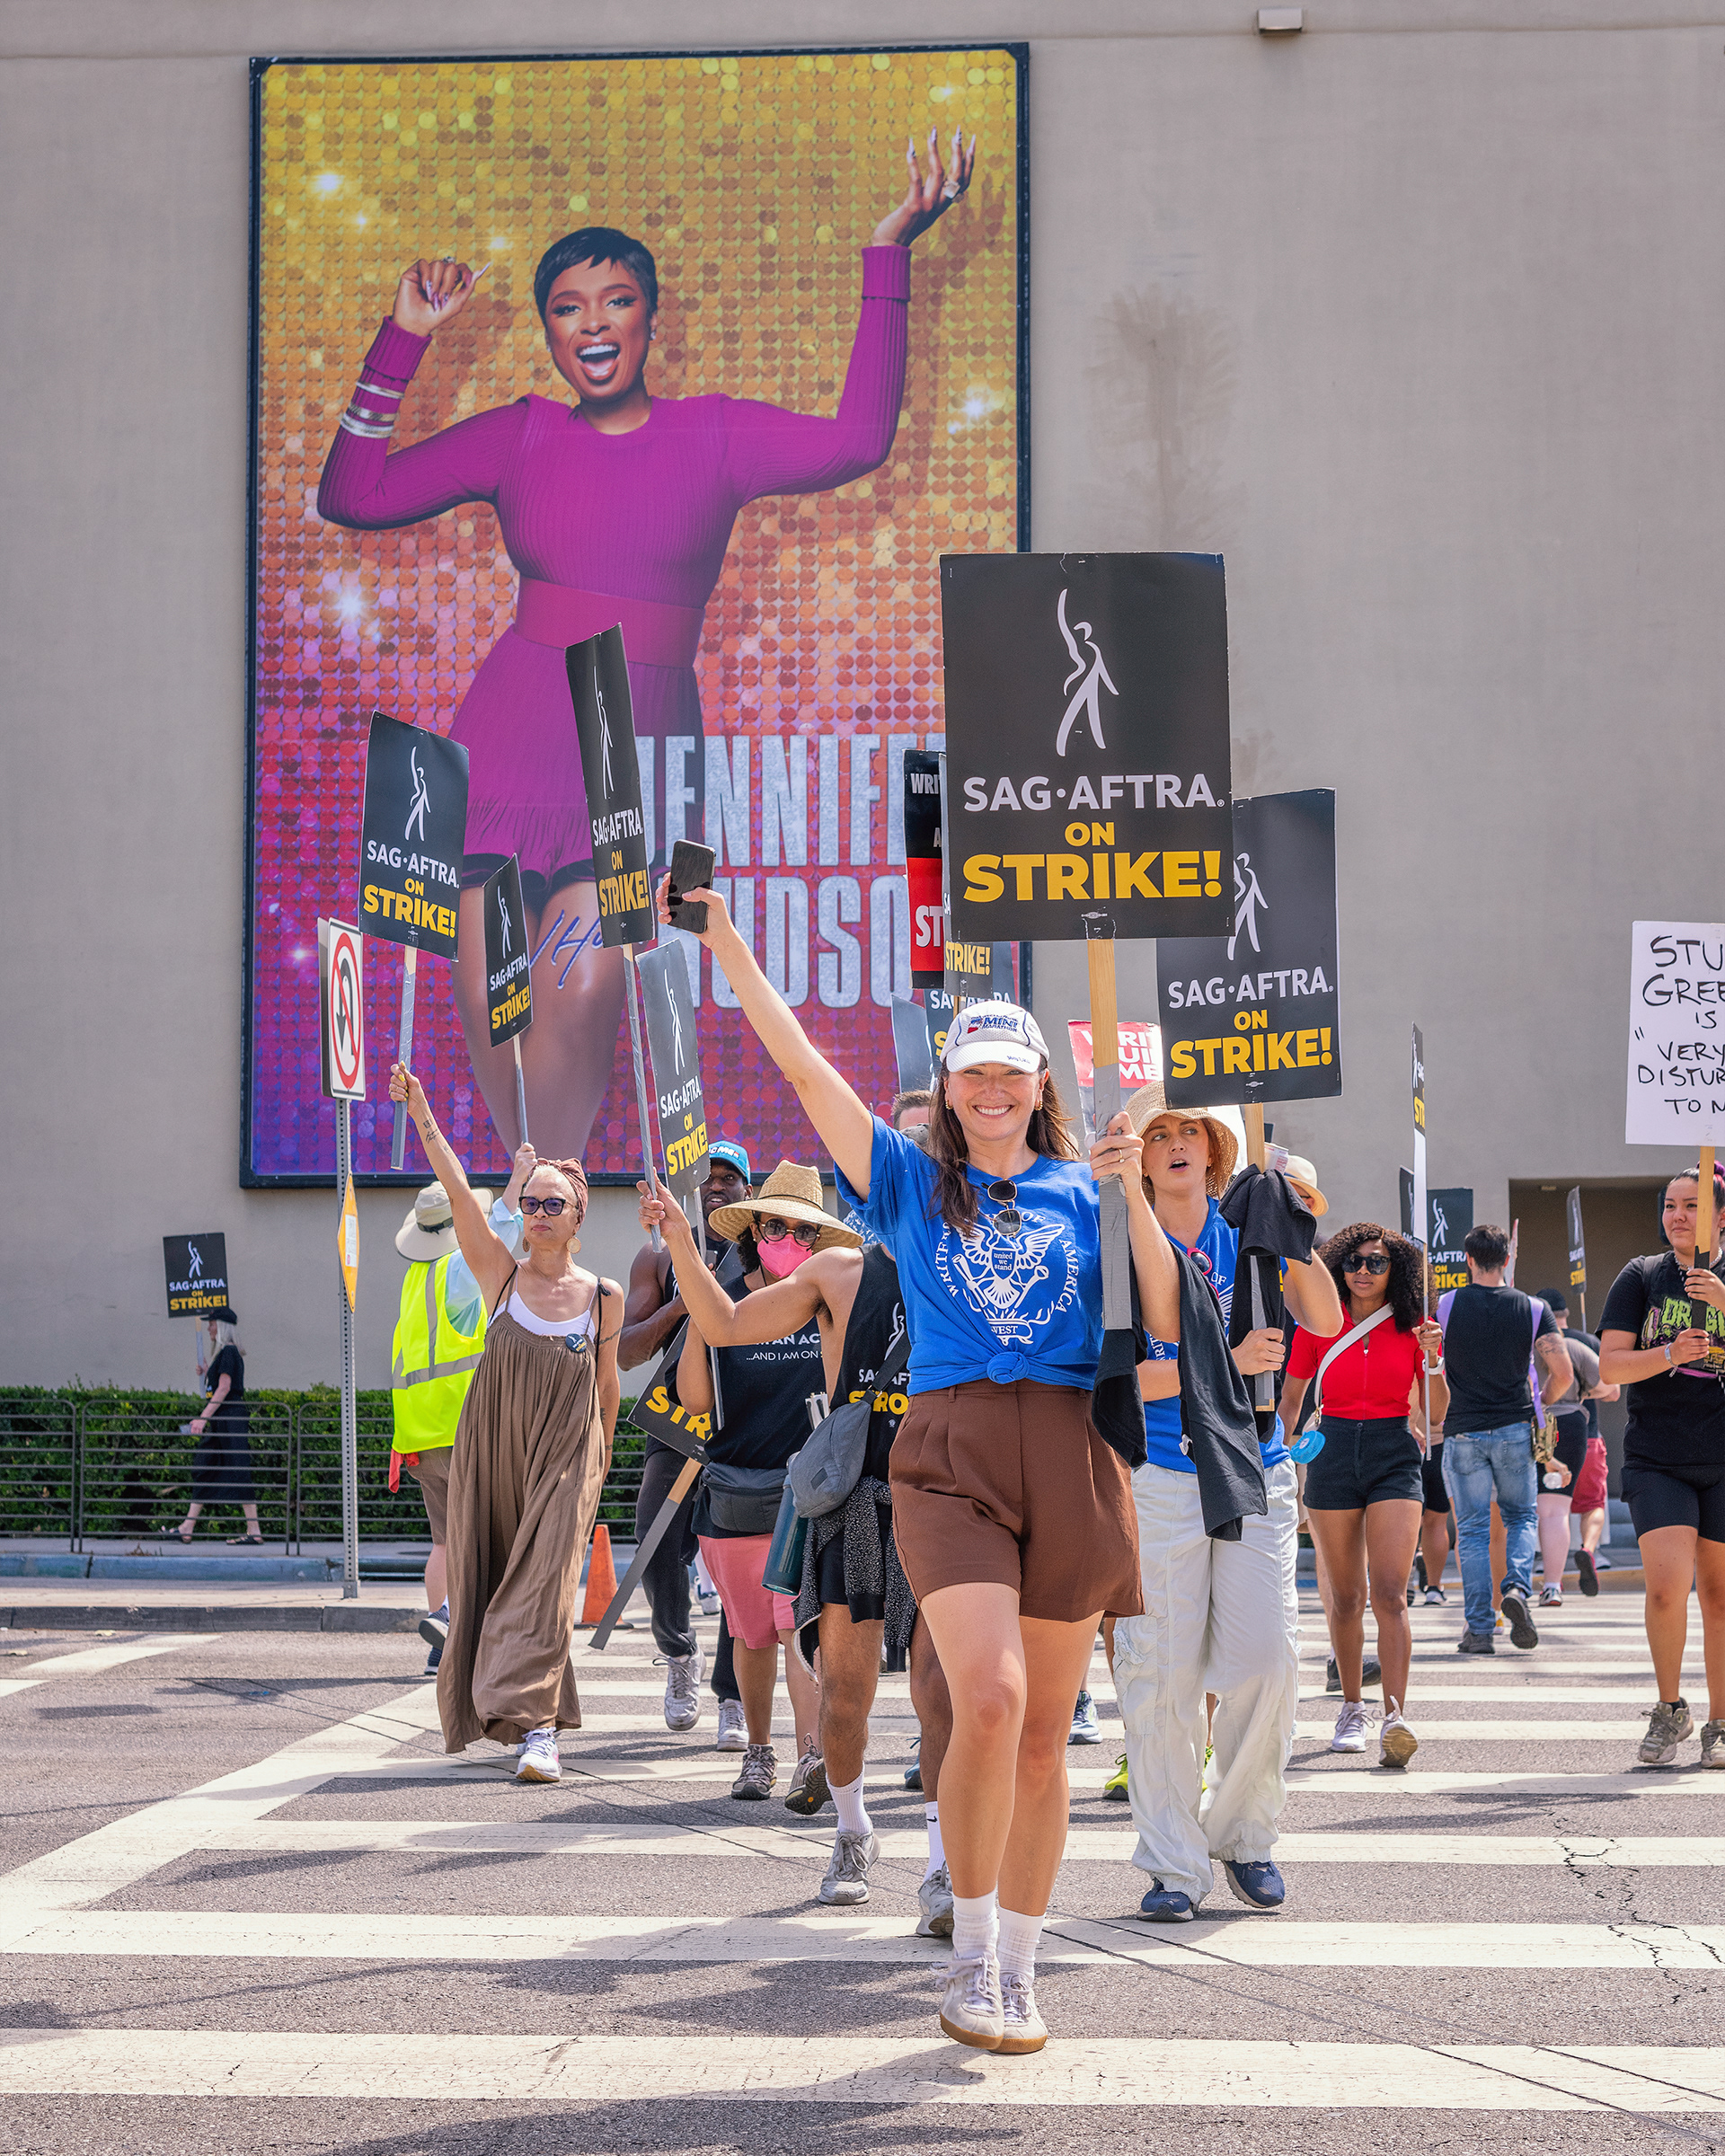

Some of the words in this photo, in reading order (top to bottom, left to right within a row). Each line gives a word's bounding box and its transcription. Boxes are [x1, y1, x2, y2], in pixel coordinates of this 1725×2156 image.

[910, 773, 941, 795] WRI
[1064, 821, 1115, 847] ON
[611, 849, 624, 871] ON
[404, 877, 425, 897] ON
[962, 850, 1223, 903] STRIKE!
[598, 869, 650, 917] STRIKE!
[362, 883, 457, 939] STRIKE!
[915, 904, 944, 948] ST
[945, 940, 991, 976] STRIKE!
[1650, 934, 1724, 971] STU
[507, 981, 517, 997] ON
[1642, 973, 1725, 1007] GREE
[491, 985, 531, 1029] STRIKE!
[984, 1017, 1018, 1029] MINI
[1234, 1009, 1269, 1031] ON
[1694, 1010, 1718, 1029] IS
[1170, 1027, 1333, 1079] STRIKE!
[1638, 1064, 1725, 1087] DISTUR
[1664, 1098, 1702, 1115] TO
[684, 1111, 694, 1132] ON
[666, 1121, 709, 1176] STRIKE!
[1021, 1211, 1046, 1223] OF
[993, 1251, 1013, 1259] united
[994, 1263, 1013, 1271] stand
[1058, 1238, 1080, 1313] AMERICA
[1434, 1264, 1448, 1274] ON
[1210, 1271, 1227, 1286] OF
[169, 1294, 227, 1311] STRIKE!
[190, 1289, 204, 1297] ON
[798, 1332, 822, 1345] AC
[782, 1350, 800, 1361] AM
[801, 1349, 818, 1359] ON
